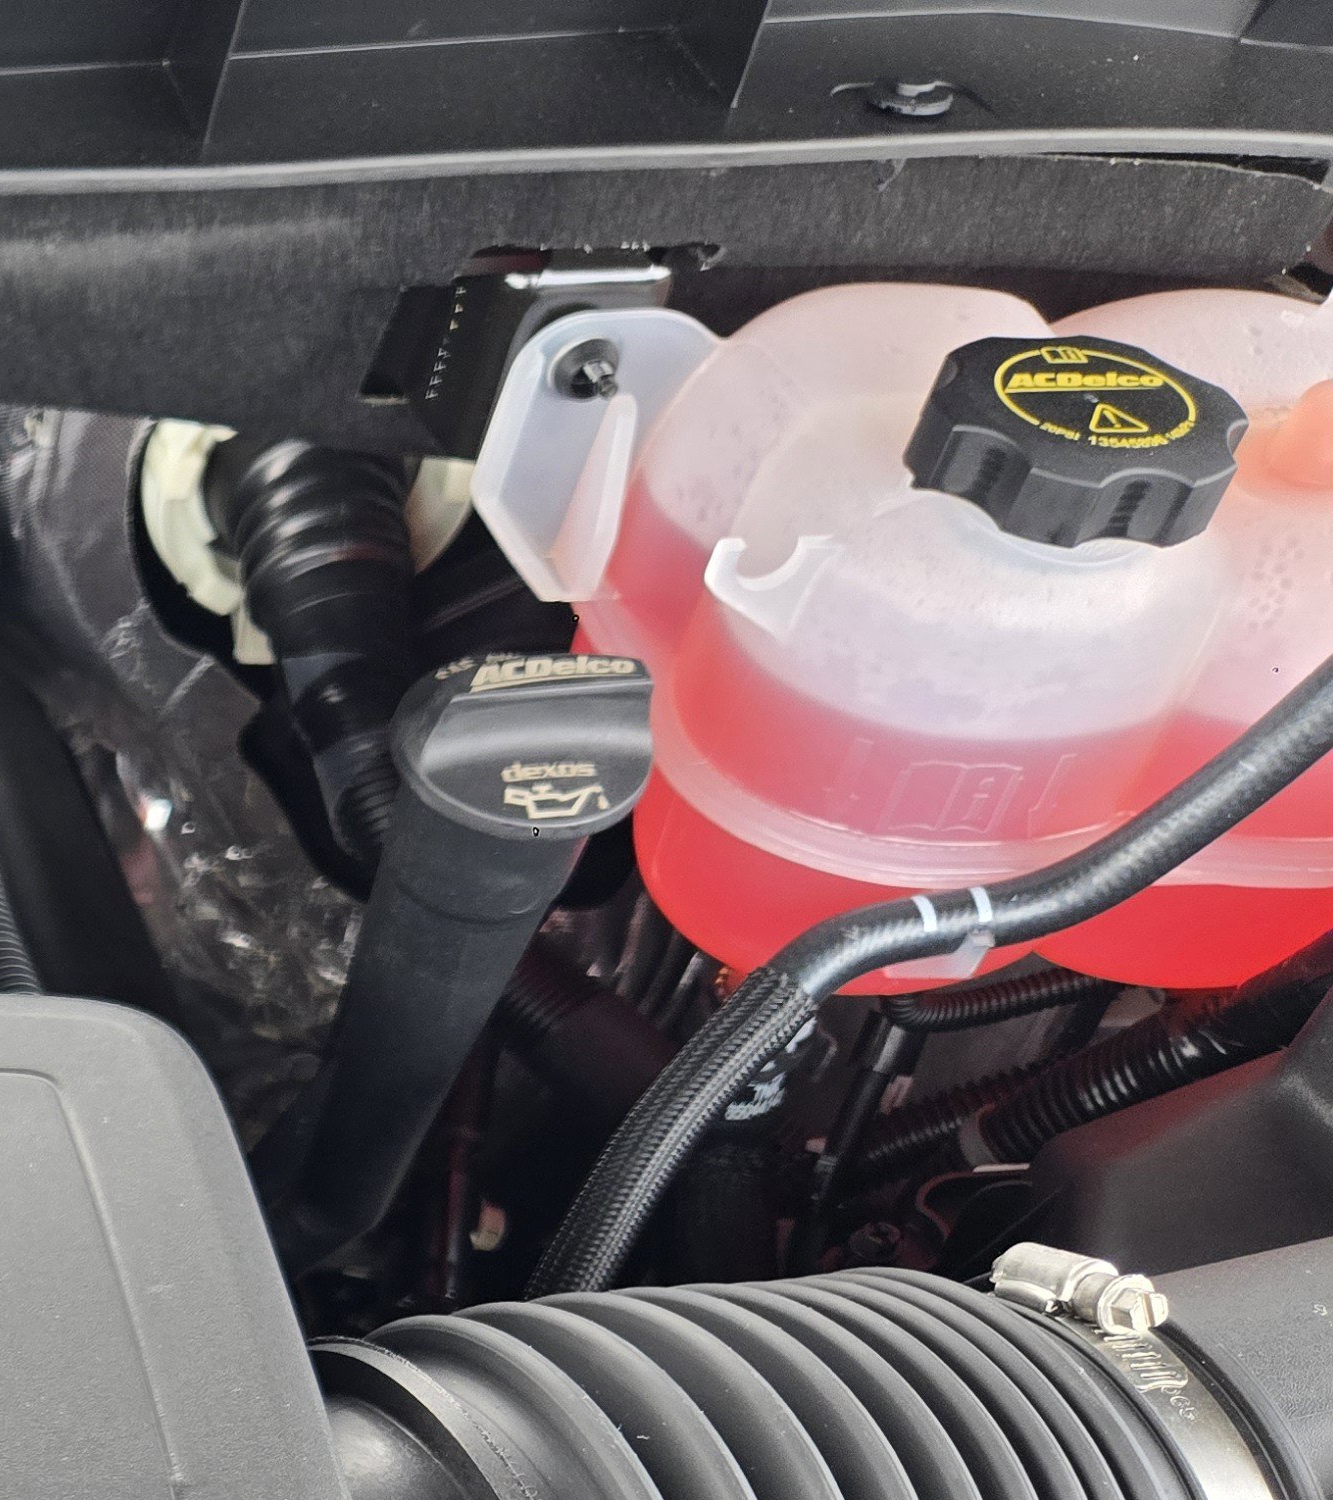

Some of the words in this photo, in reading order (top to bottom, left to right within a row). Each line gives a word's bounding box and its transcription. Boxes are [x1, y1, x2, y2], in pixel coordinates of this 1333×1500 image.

[1006, 371, 1165, 390] ACDelco
[469, 655, 638, 688] ACDelco
[500, 761, 597, 783] dexos
